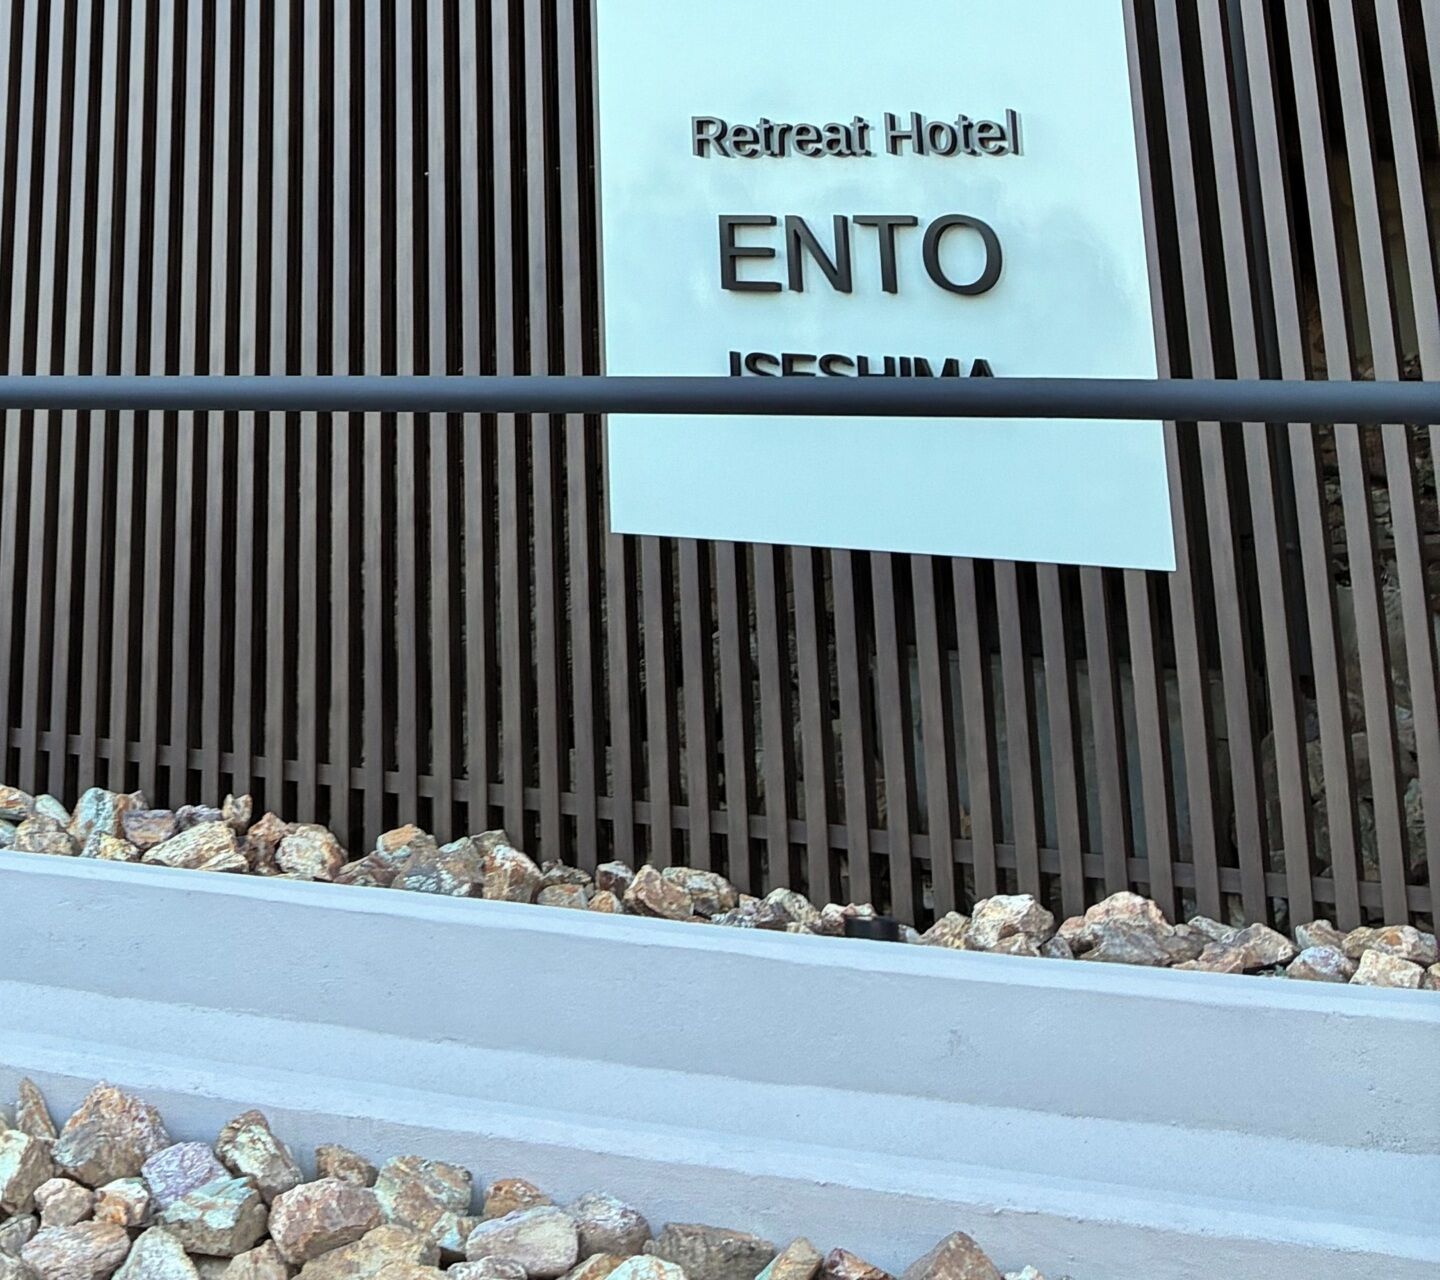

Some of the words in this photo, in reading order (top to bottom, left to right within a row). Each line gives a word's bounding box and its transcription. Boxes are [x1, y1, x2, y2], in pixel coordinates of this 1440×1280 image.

[691, 115, 872, 158] Retreat
[883, 108, 1022, 157] Hotel
[718, 213, 1003, 297] ENTO
